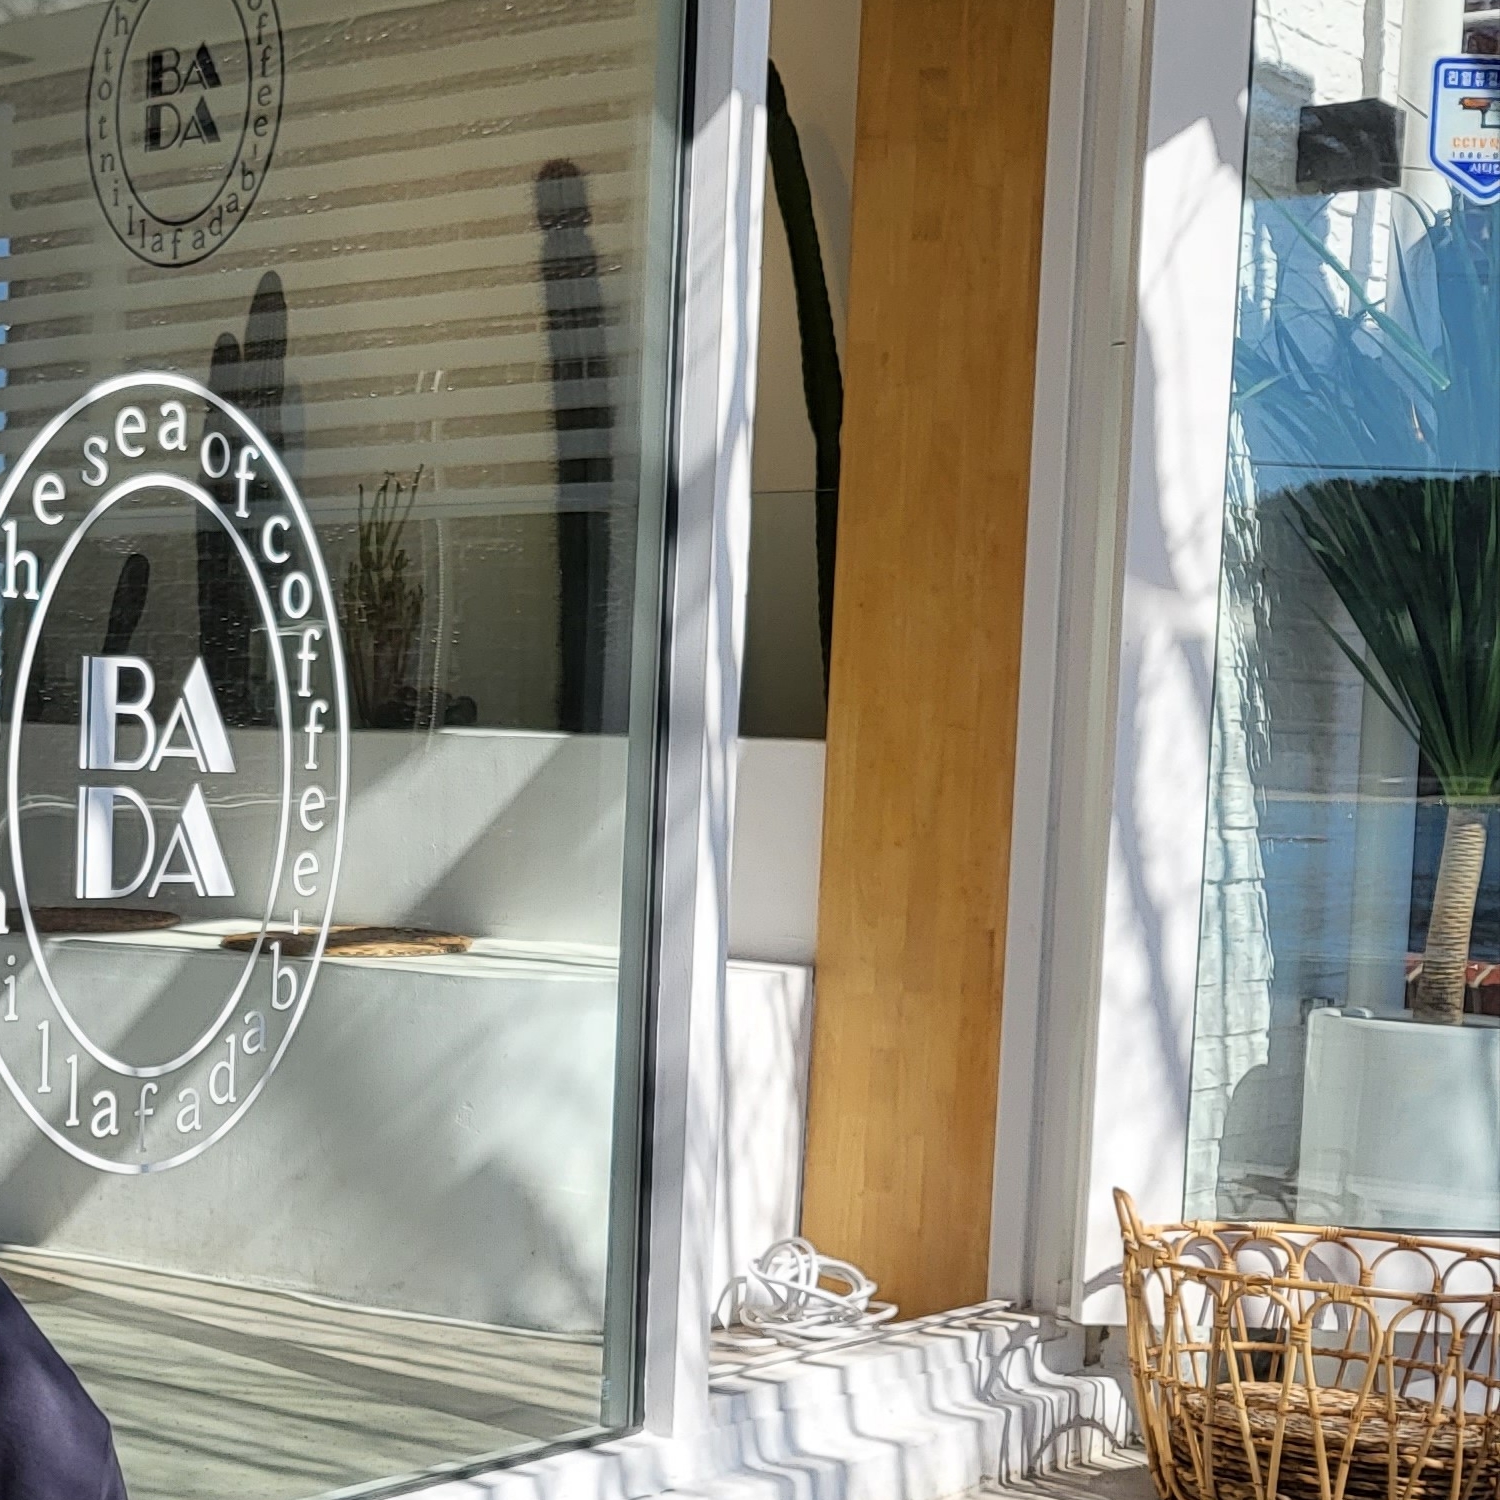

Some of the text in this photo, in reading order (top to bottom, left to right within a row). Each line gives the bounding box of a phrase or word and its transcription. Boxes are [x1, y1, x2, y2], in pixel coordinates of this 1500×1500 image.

[145, 41, 222, 99] BA
[144, 96, 221, 152] DA
[79, 655, 236, 773] BA
[75, 782, 236, 899] DA
